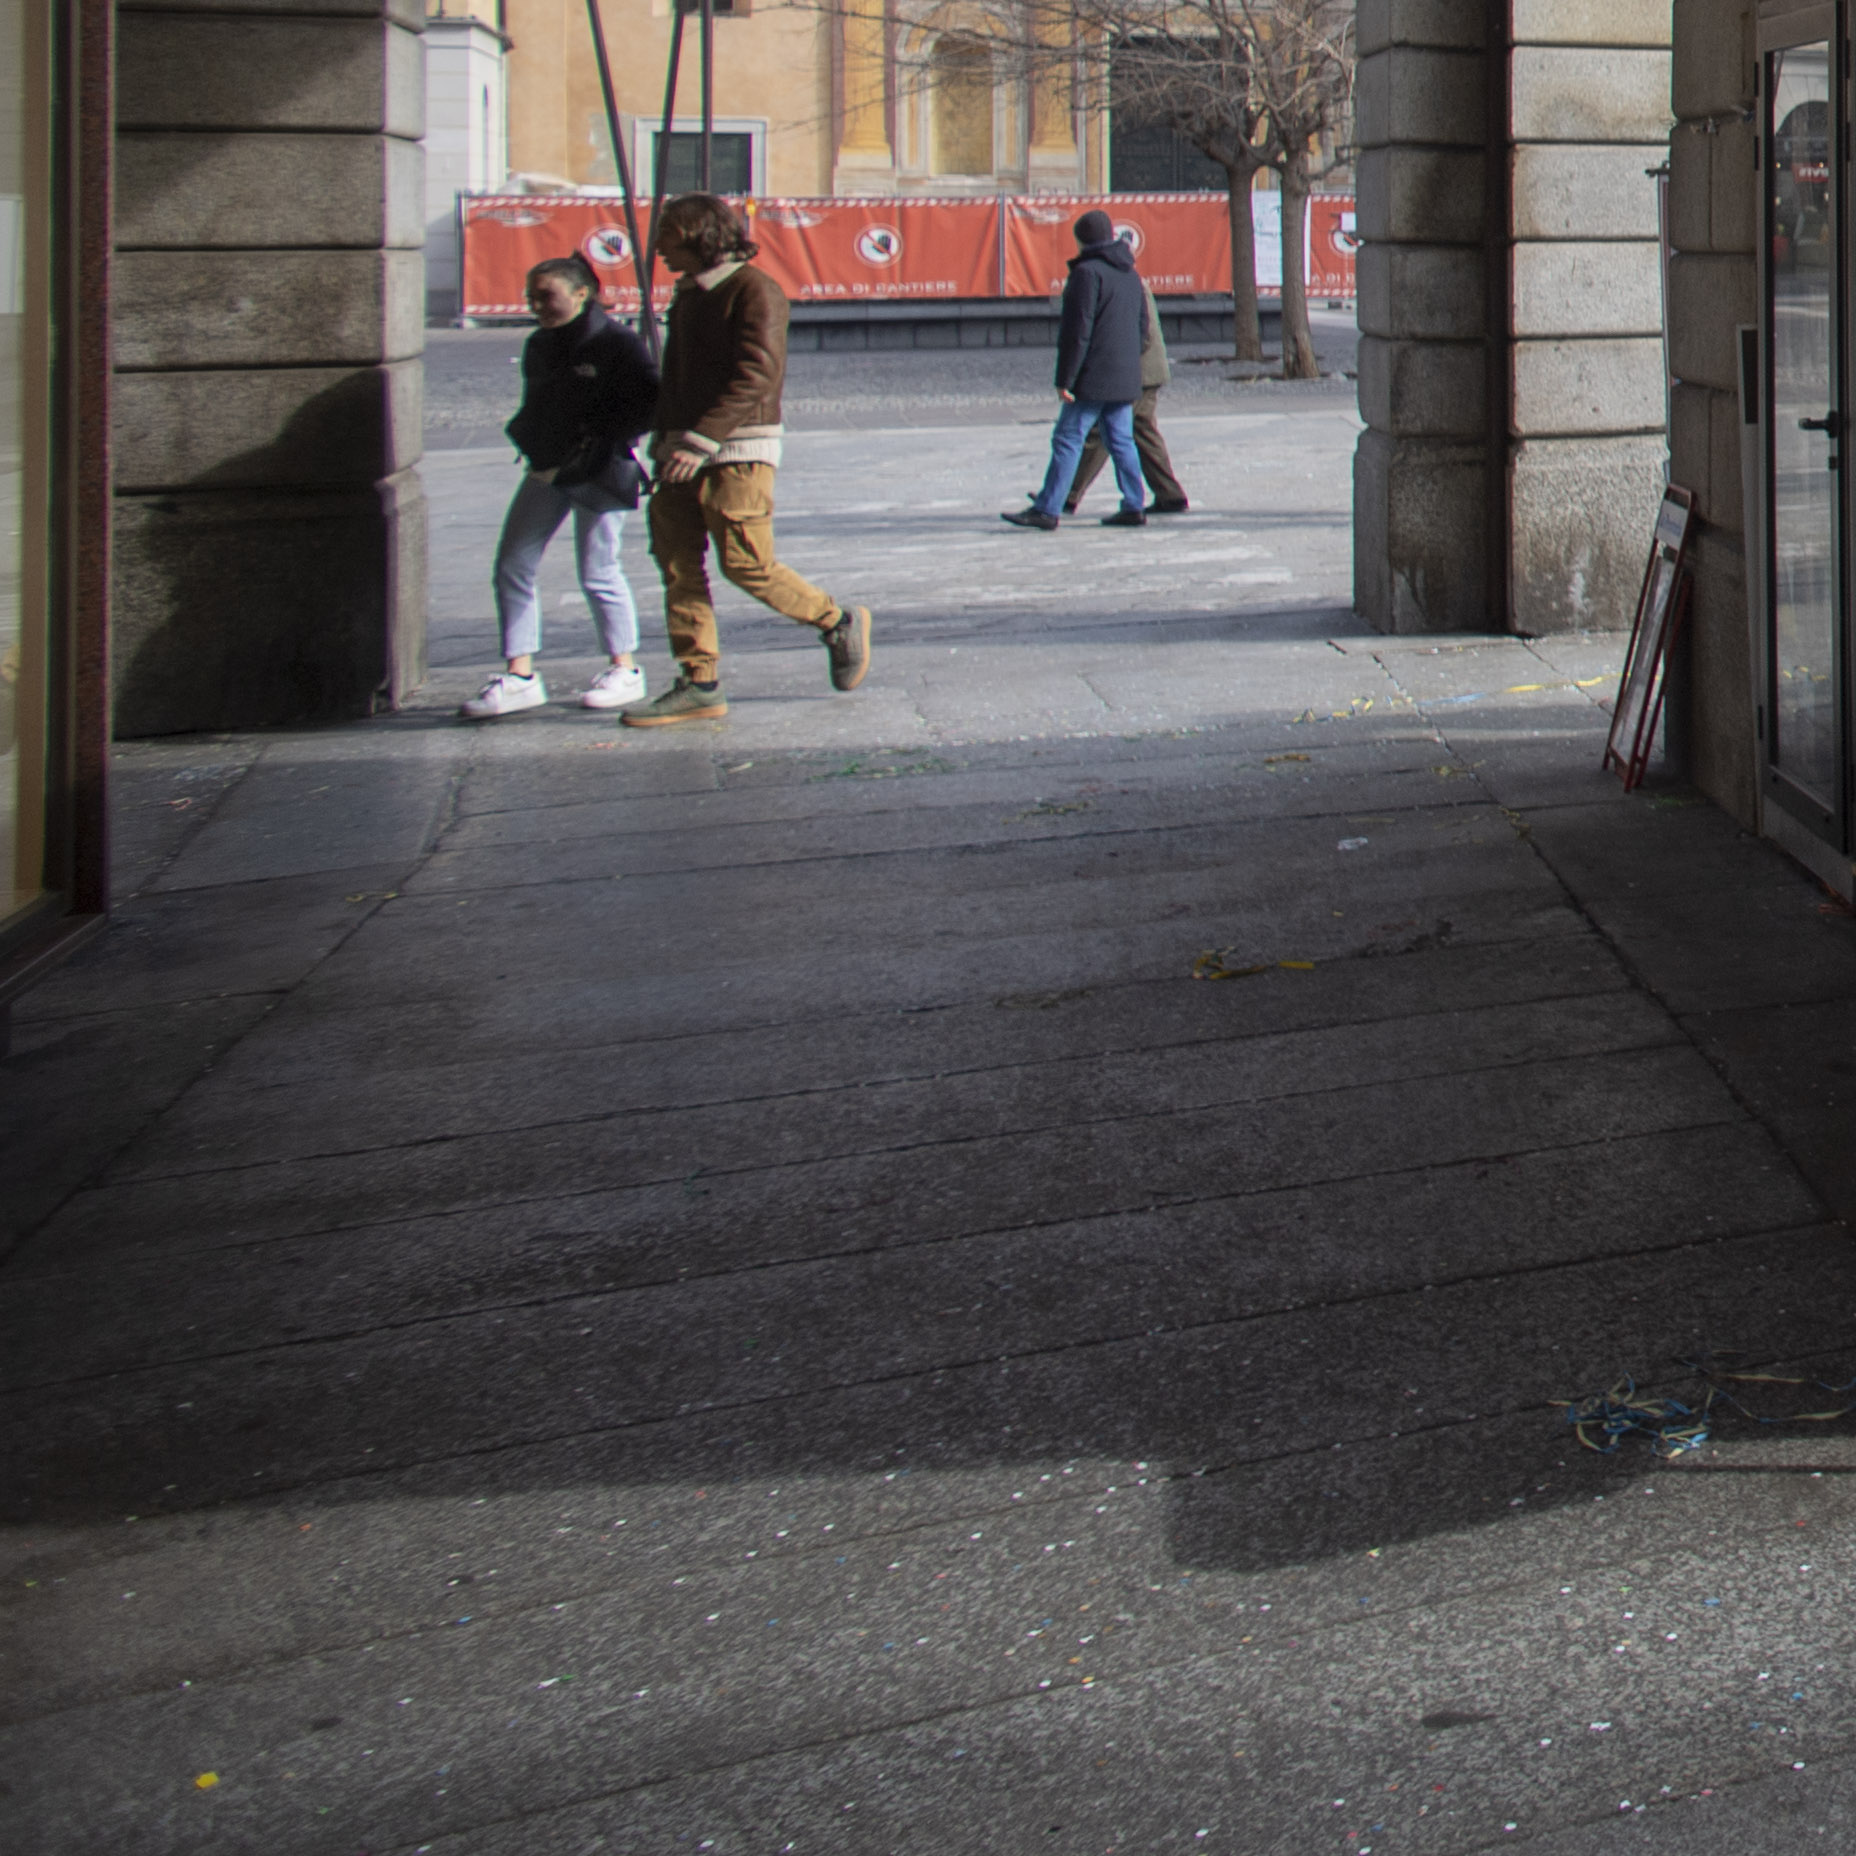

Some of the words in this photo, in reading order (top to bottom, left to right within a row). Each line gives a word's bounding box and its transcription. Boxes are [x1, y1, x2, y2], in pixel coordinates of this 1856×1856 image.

[801, 282, 847, 295] AREA
[852, 282, 870, 294] DI
[876, 280, 958, 294] CANTIERE
